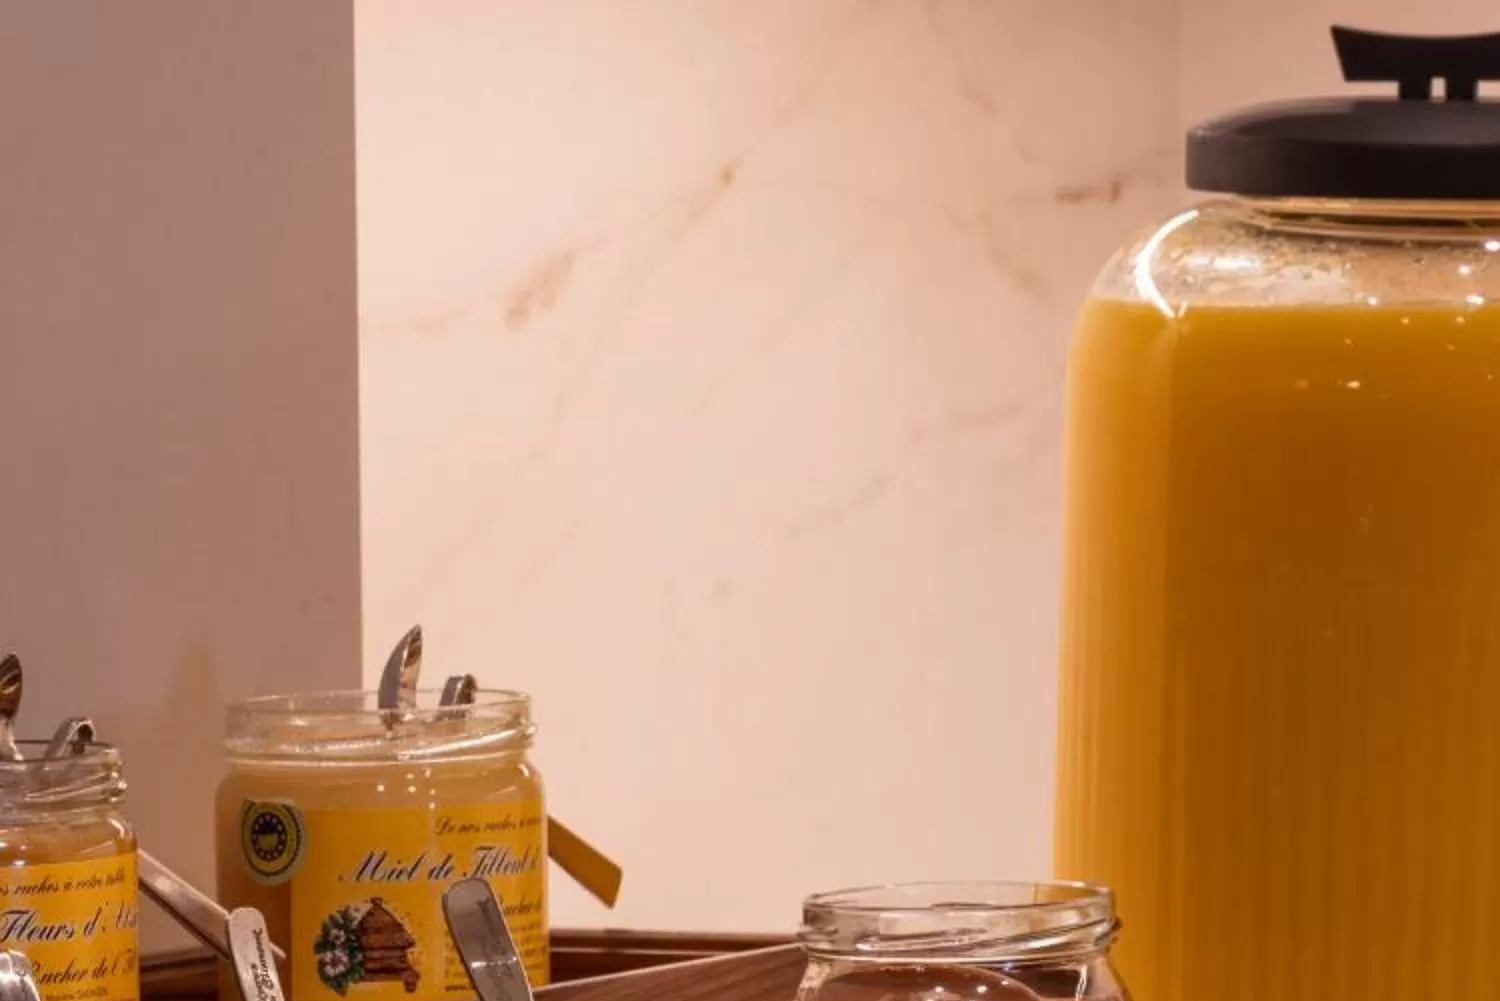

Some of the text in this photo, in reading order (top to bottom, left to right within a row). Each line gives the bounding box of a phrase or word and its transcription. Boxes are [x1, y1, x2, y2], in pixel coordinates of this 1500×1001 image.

[338, 850, 426, 881] Miel
[428, 852, 455, 880] de
[0, 908, 76, 943] Fleurs
